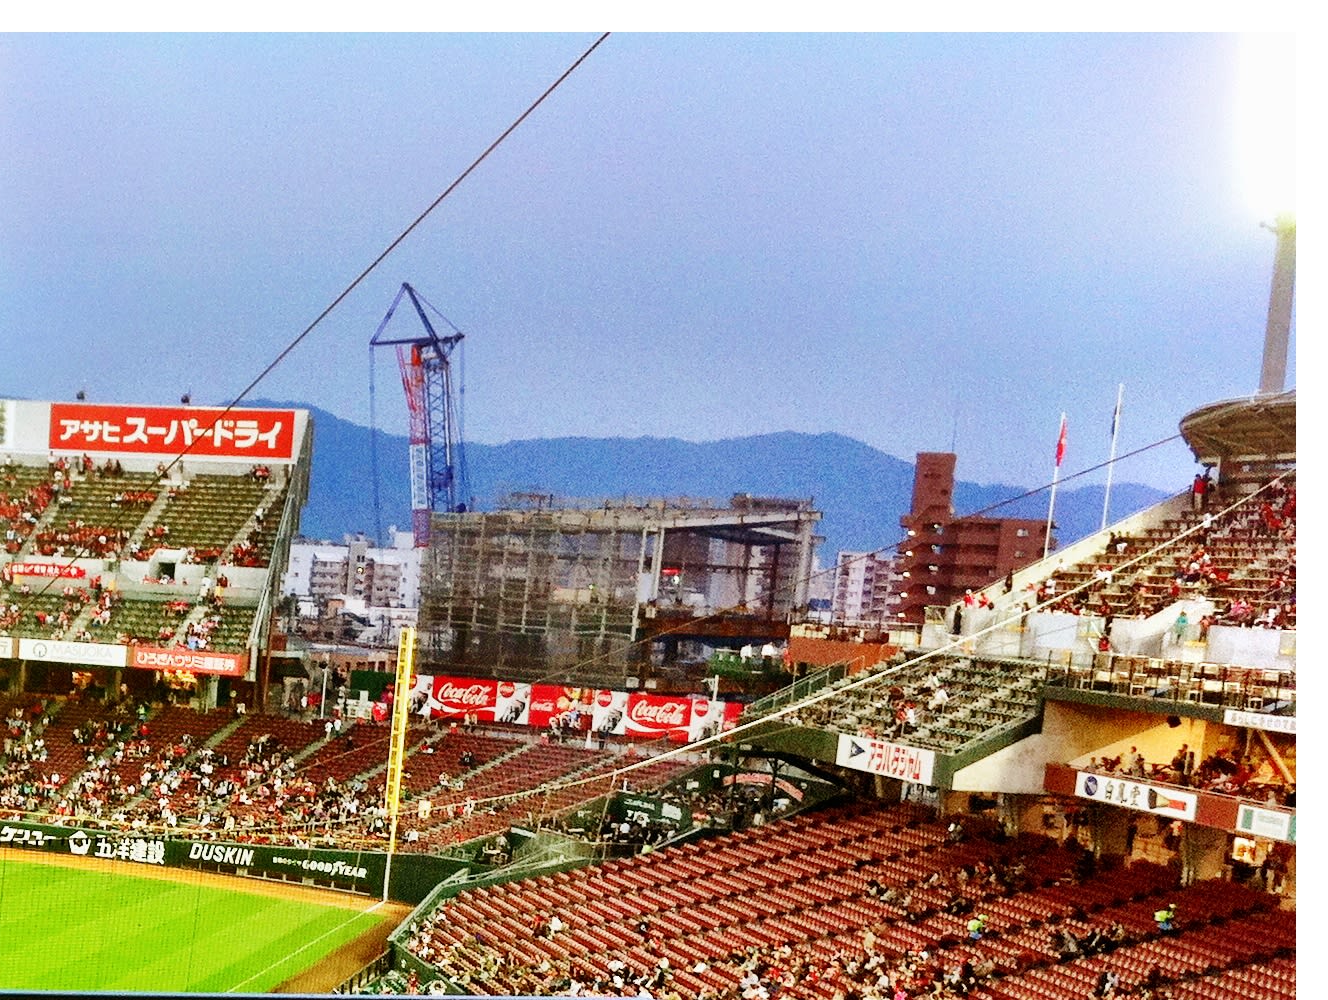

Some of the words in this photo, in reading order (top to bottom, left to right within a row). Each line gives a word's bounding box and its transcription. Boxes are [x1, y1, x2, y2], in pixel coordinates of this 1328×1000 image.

[437, 682, 493, 706] Coca-Cola
[631, 699, 688, 725] Coca-Cola
[189, 843, 254, 866] DUSKIN
[301, 860, 368, 879] GOODYEAR
